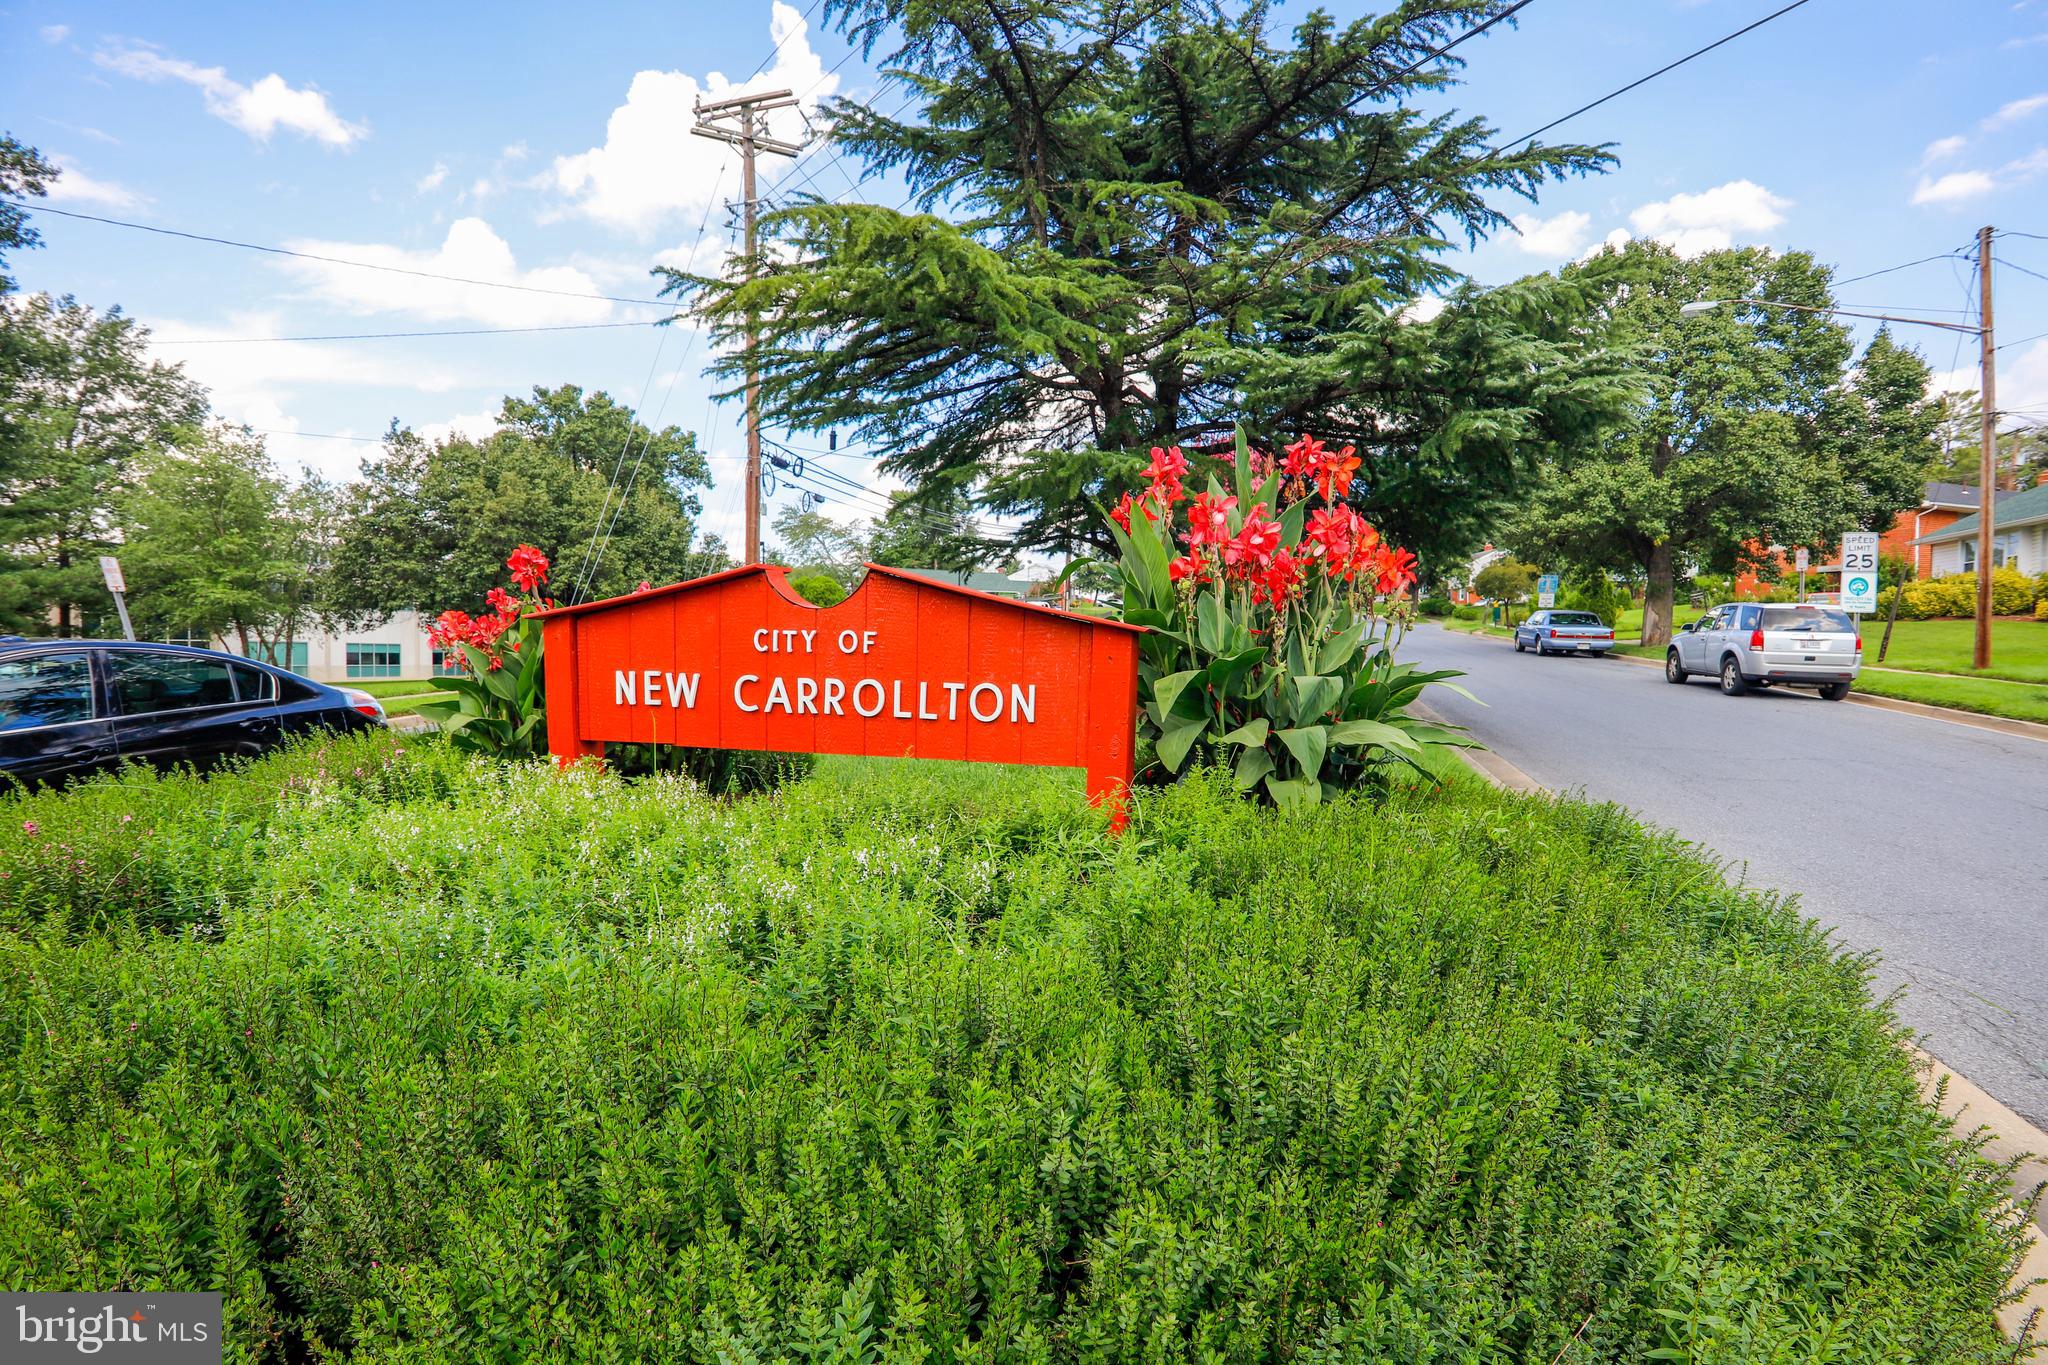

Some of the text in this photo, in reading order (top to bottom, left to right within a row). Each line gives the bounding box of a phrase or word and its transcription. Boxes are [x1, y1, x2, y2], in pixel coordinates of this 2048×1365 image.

[1845, 536, 1875, 544] SPEED
[1845, 553, 1873, 569] 25
[752, 628, 878, 654] CITY OF
[614, 670, 1037, 723] NEW CARROLLTON
